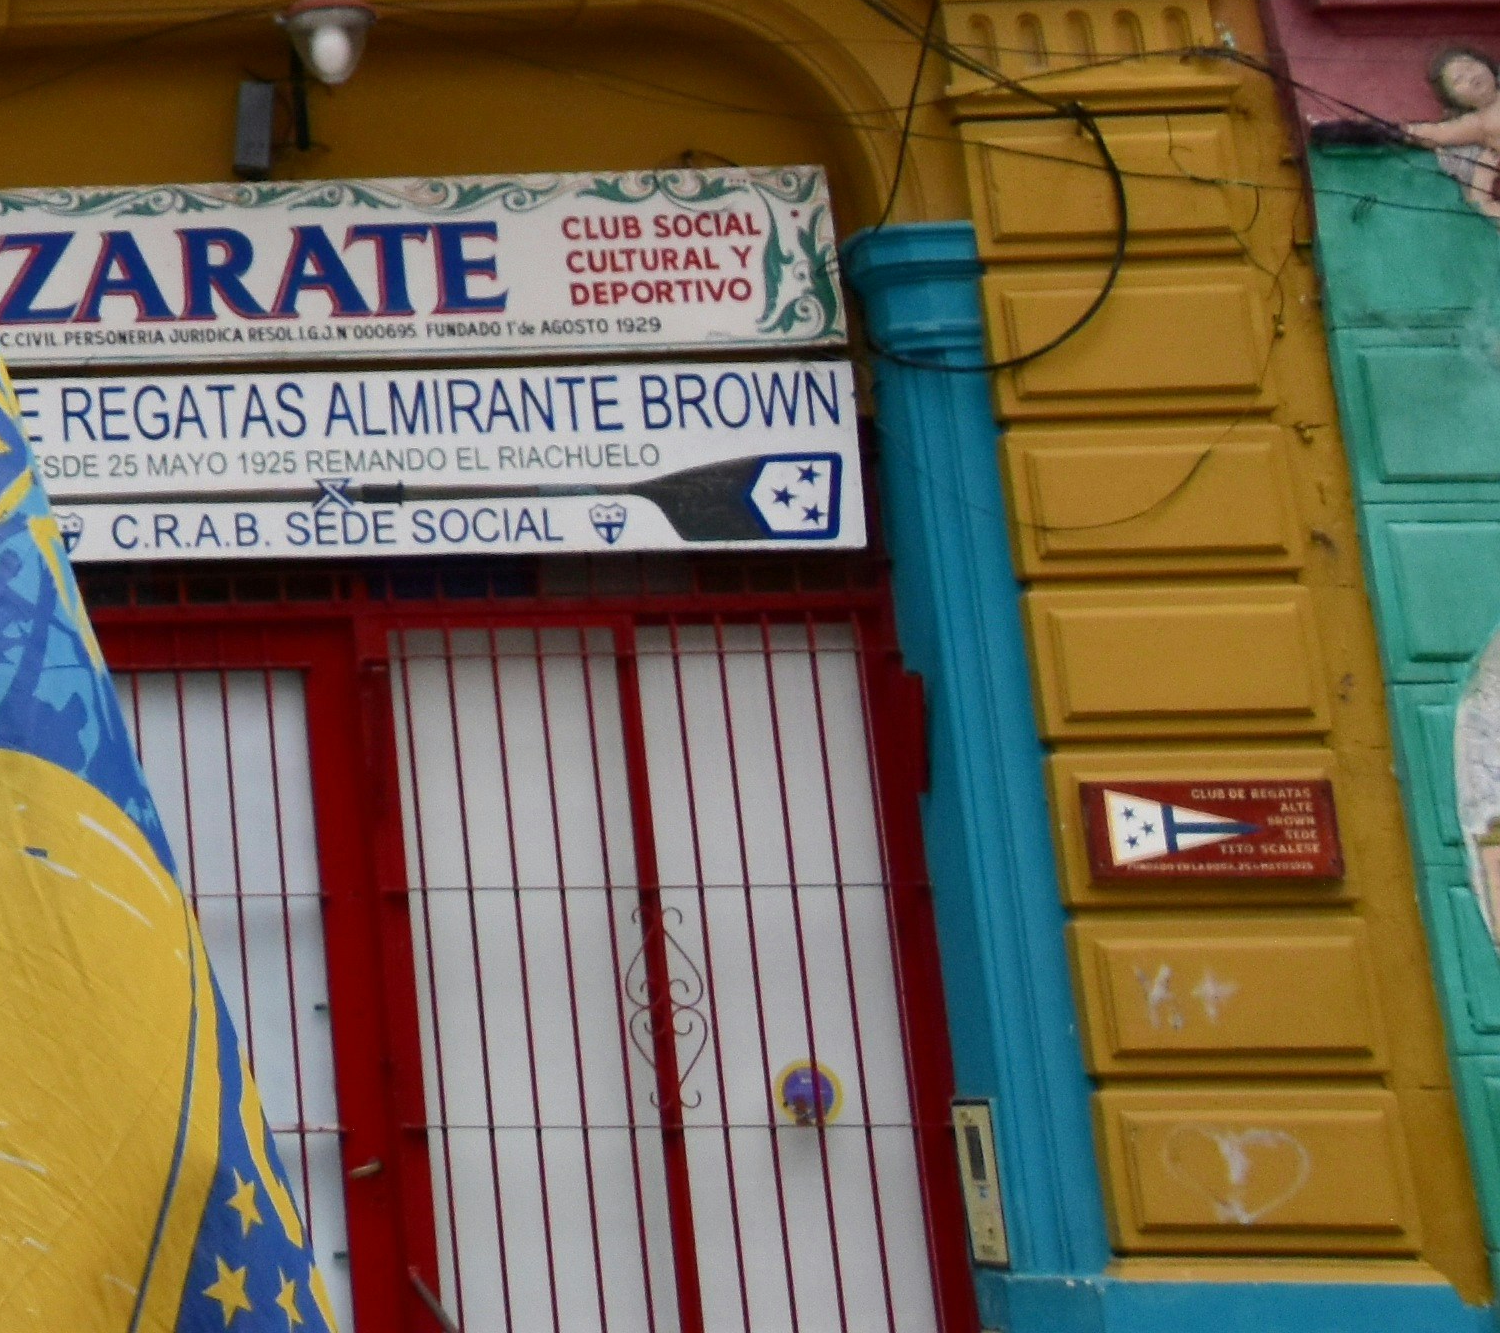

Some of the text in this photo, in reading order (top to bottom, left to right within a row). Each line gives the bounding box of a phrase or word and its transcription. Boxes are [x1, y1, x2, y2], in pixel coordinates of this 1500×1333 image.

[561, 211, 762, 240] CLUB SOCIAL
[565, 244, 752, 274] CULTURAL Y
[569, 276, 753, 307] DEPORTIVO
[64, 328, 166, 346] PERSONERIA
[170, 325, 243, 344] JURIDICA
[426, 320, 500, 338] FUNDADO
[540, 317, 609, 335] AGOSTO
[615, 315, 662, 334] 1929
[14, 369, 841, 443] E REGATAS ALMIRANTE BROWN
[108, 453, 139, 478] 25
[147, 451, 229, 477] MAYO
[239, 449, 297, 474] 1925
[305, 447, 447, 474] REMANDO
[456, 446, 489, 471] EL
[498, 442, 660, 470] RIACHUELO
[111, 507, 564, 551] C.R.A.B. SEDE SOCIAL
[1191, 787, 1312, 800] CLUB DE REGATAS
[1266, 815, 1316, 827] BROWN
